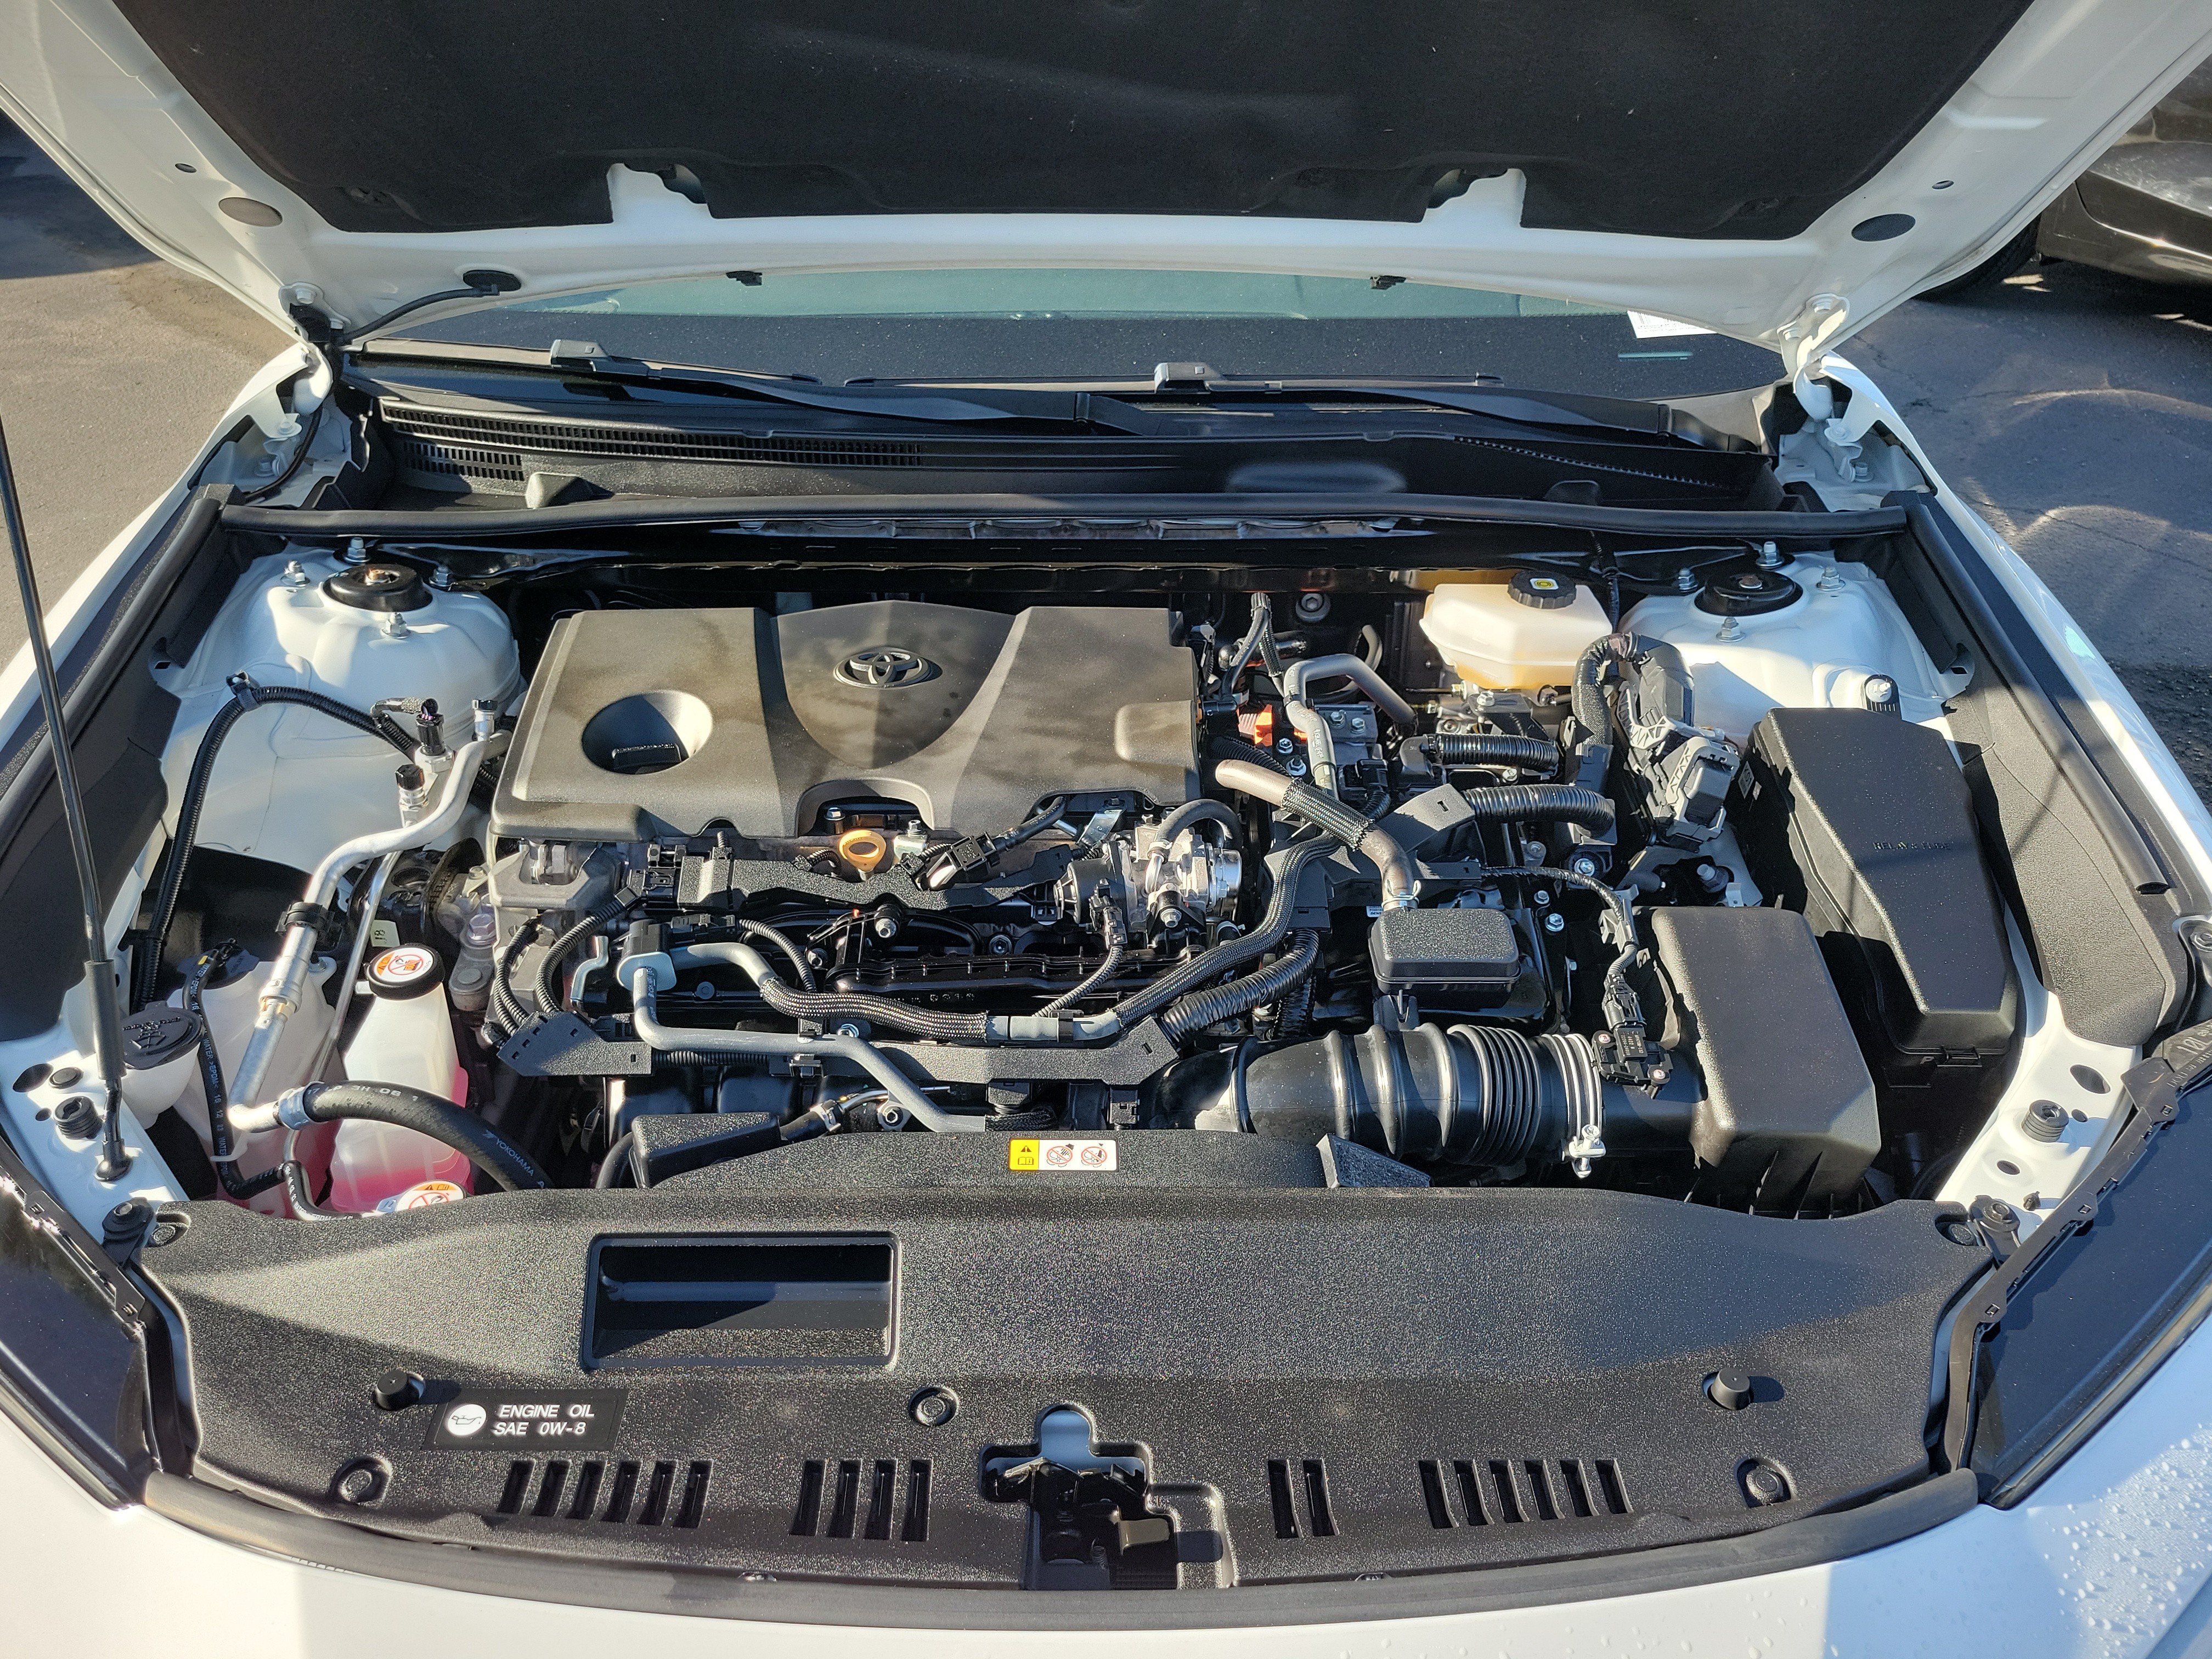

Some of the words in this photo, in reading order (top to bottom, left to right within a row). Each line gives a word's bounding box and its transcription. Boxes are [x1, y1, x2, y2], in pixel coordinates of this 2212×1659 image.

[203, 1038, 214, 1060] WATER
[496, 1138, 534, 1177] YOKOHAMA
[498, 1404, 559, 1418] ENGINE
[569, 1404, 595, 1418] OIL
[493, 1421, 528, 1436] SAE
[539, 1421, 586, 1436] 0W-8
